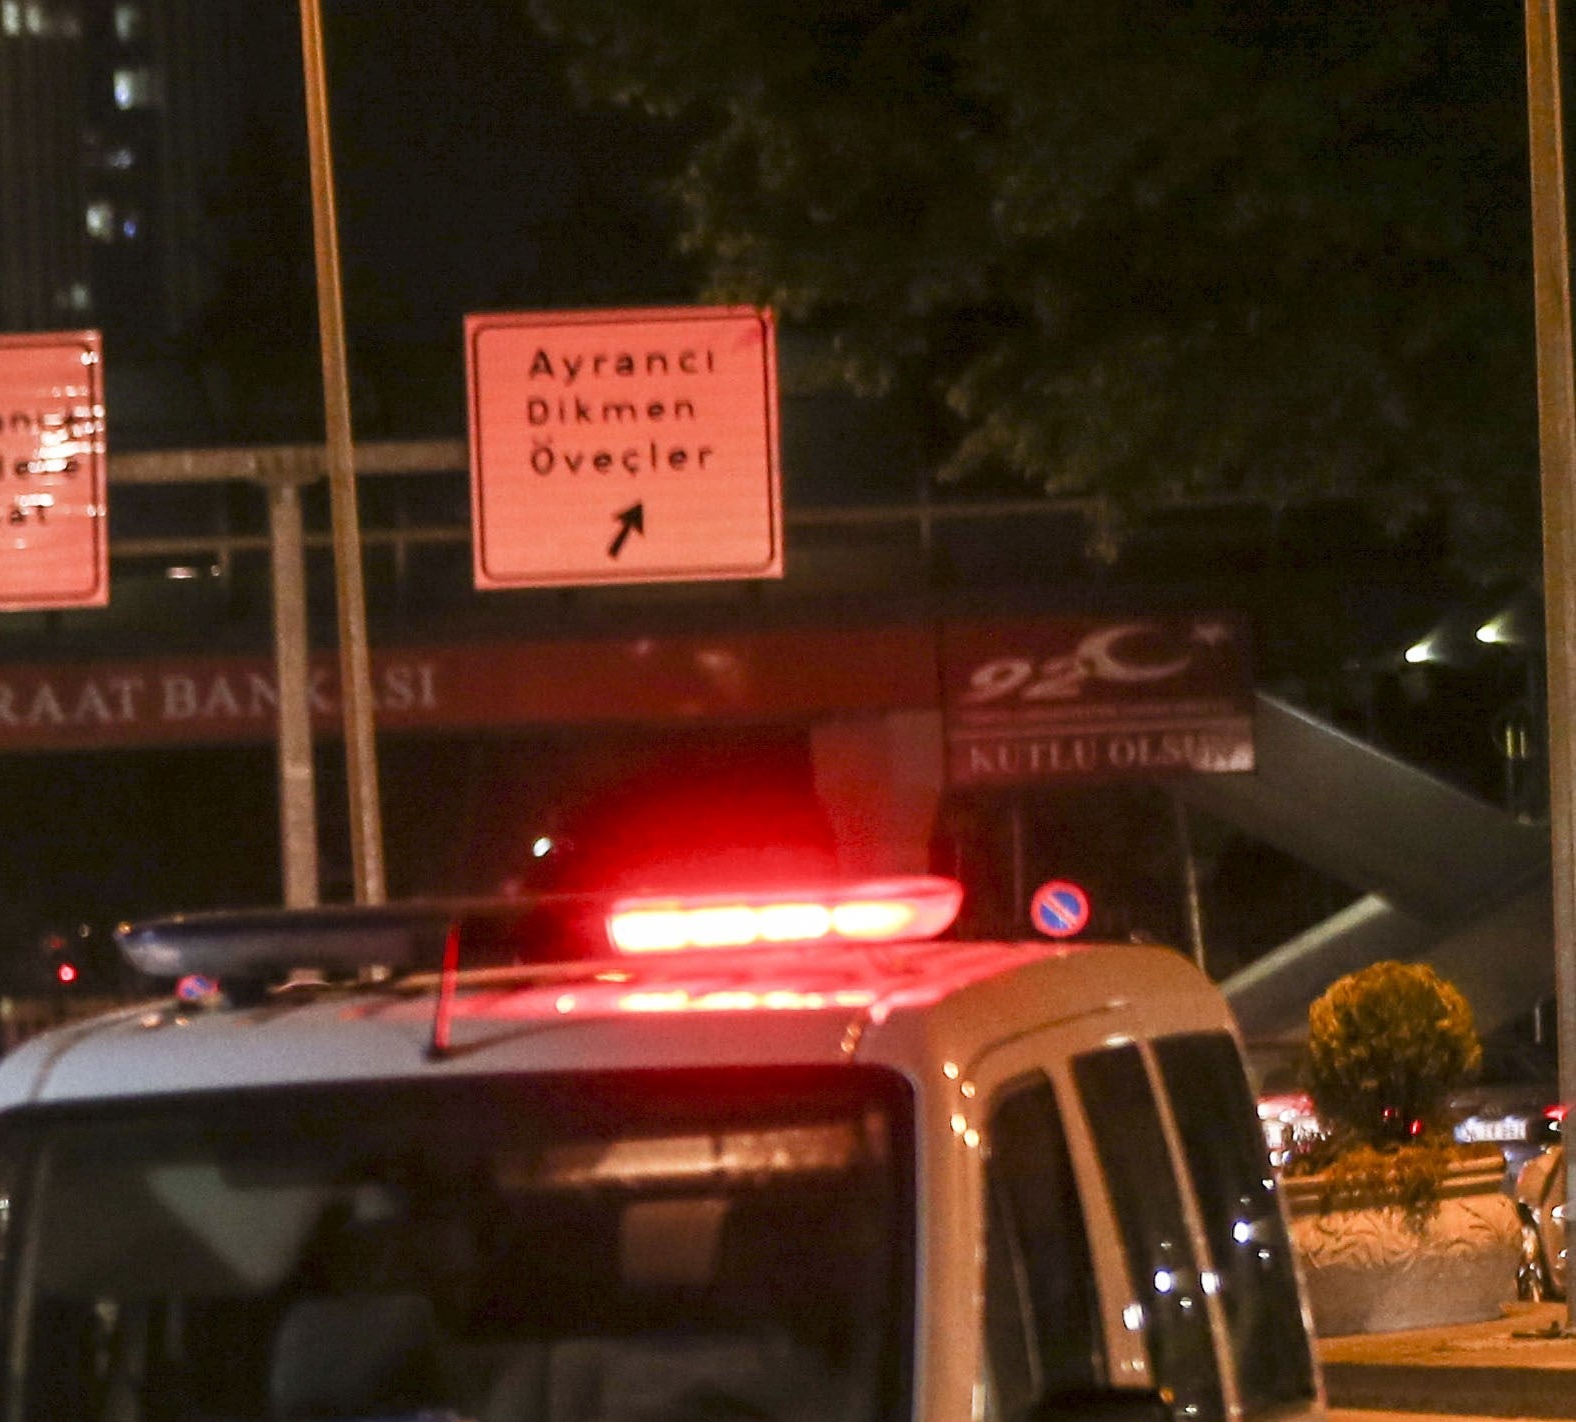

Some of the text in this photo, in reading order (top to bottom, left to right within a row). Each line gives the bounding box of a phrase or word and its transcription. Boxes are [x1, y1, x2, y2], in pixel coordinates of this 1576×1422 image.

[529, 348, 714, 386] Ayrancı
[527, 395, 695, 426] Dikmen
[529, 436, 714, 476] Öveçler
[160, 664, 439, 720] BANKSI
[1108, 732, 1253, 770] OLSU
